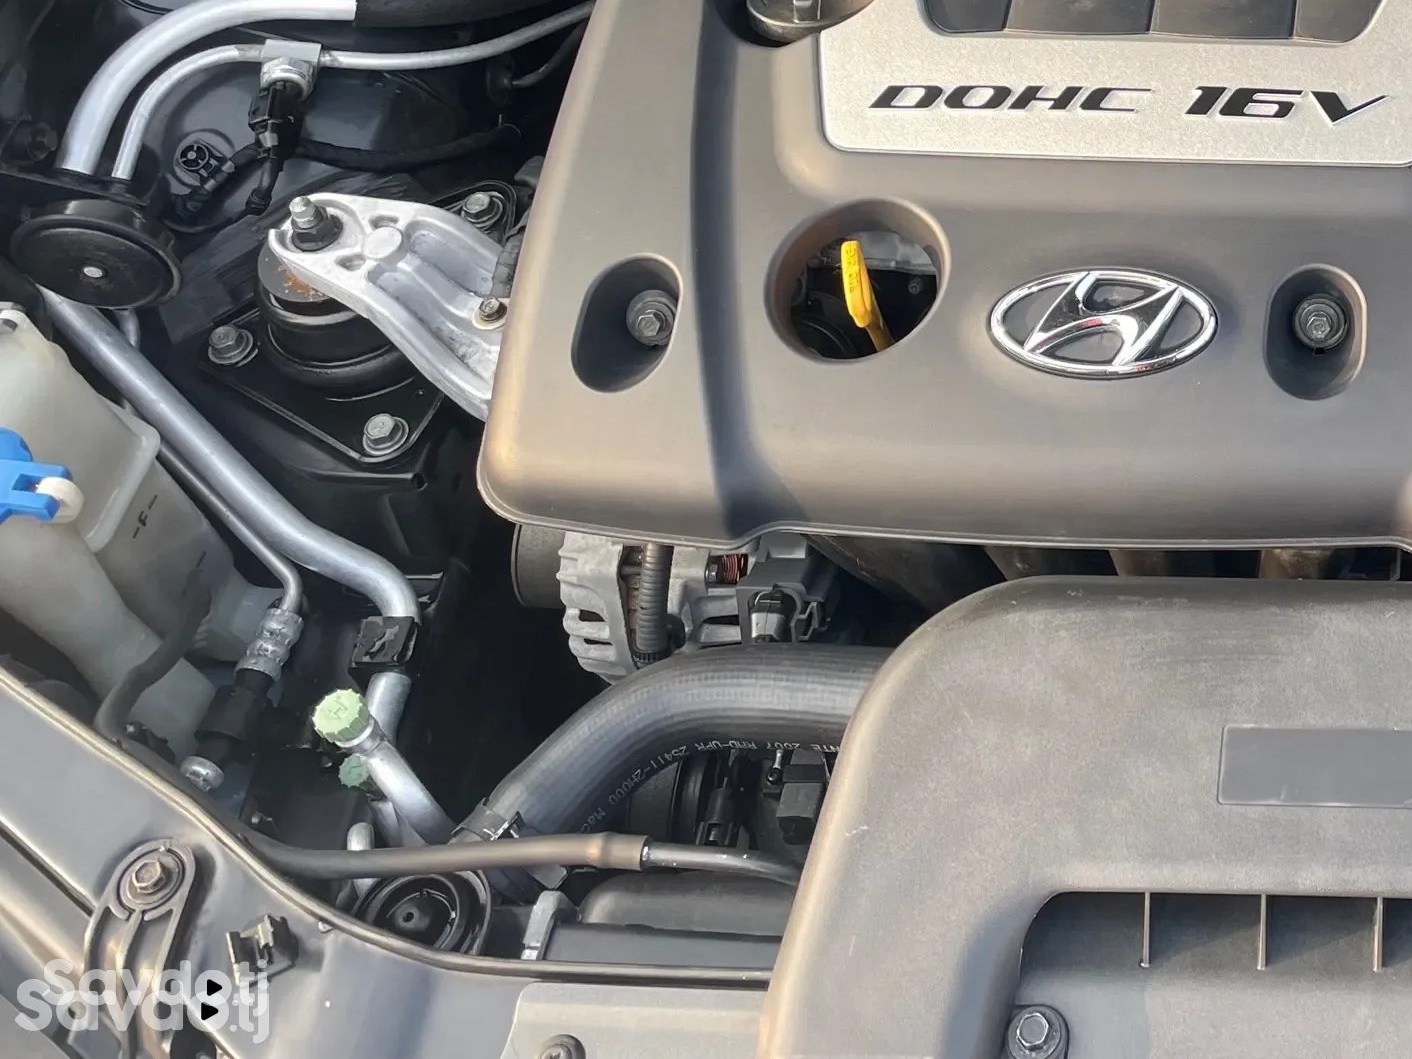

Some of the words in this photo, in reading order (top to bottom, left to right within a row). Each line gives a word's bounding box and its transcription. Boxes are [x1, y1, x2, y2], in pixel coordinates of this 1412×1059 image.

[868, 85, 1154, 112] DOHC
[1185, 85, 1390, 126] 16V
[608, 745, 690, 806] 25411-2H000
